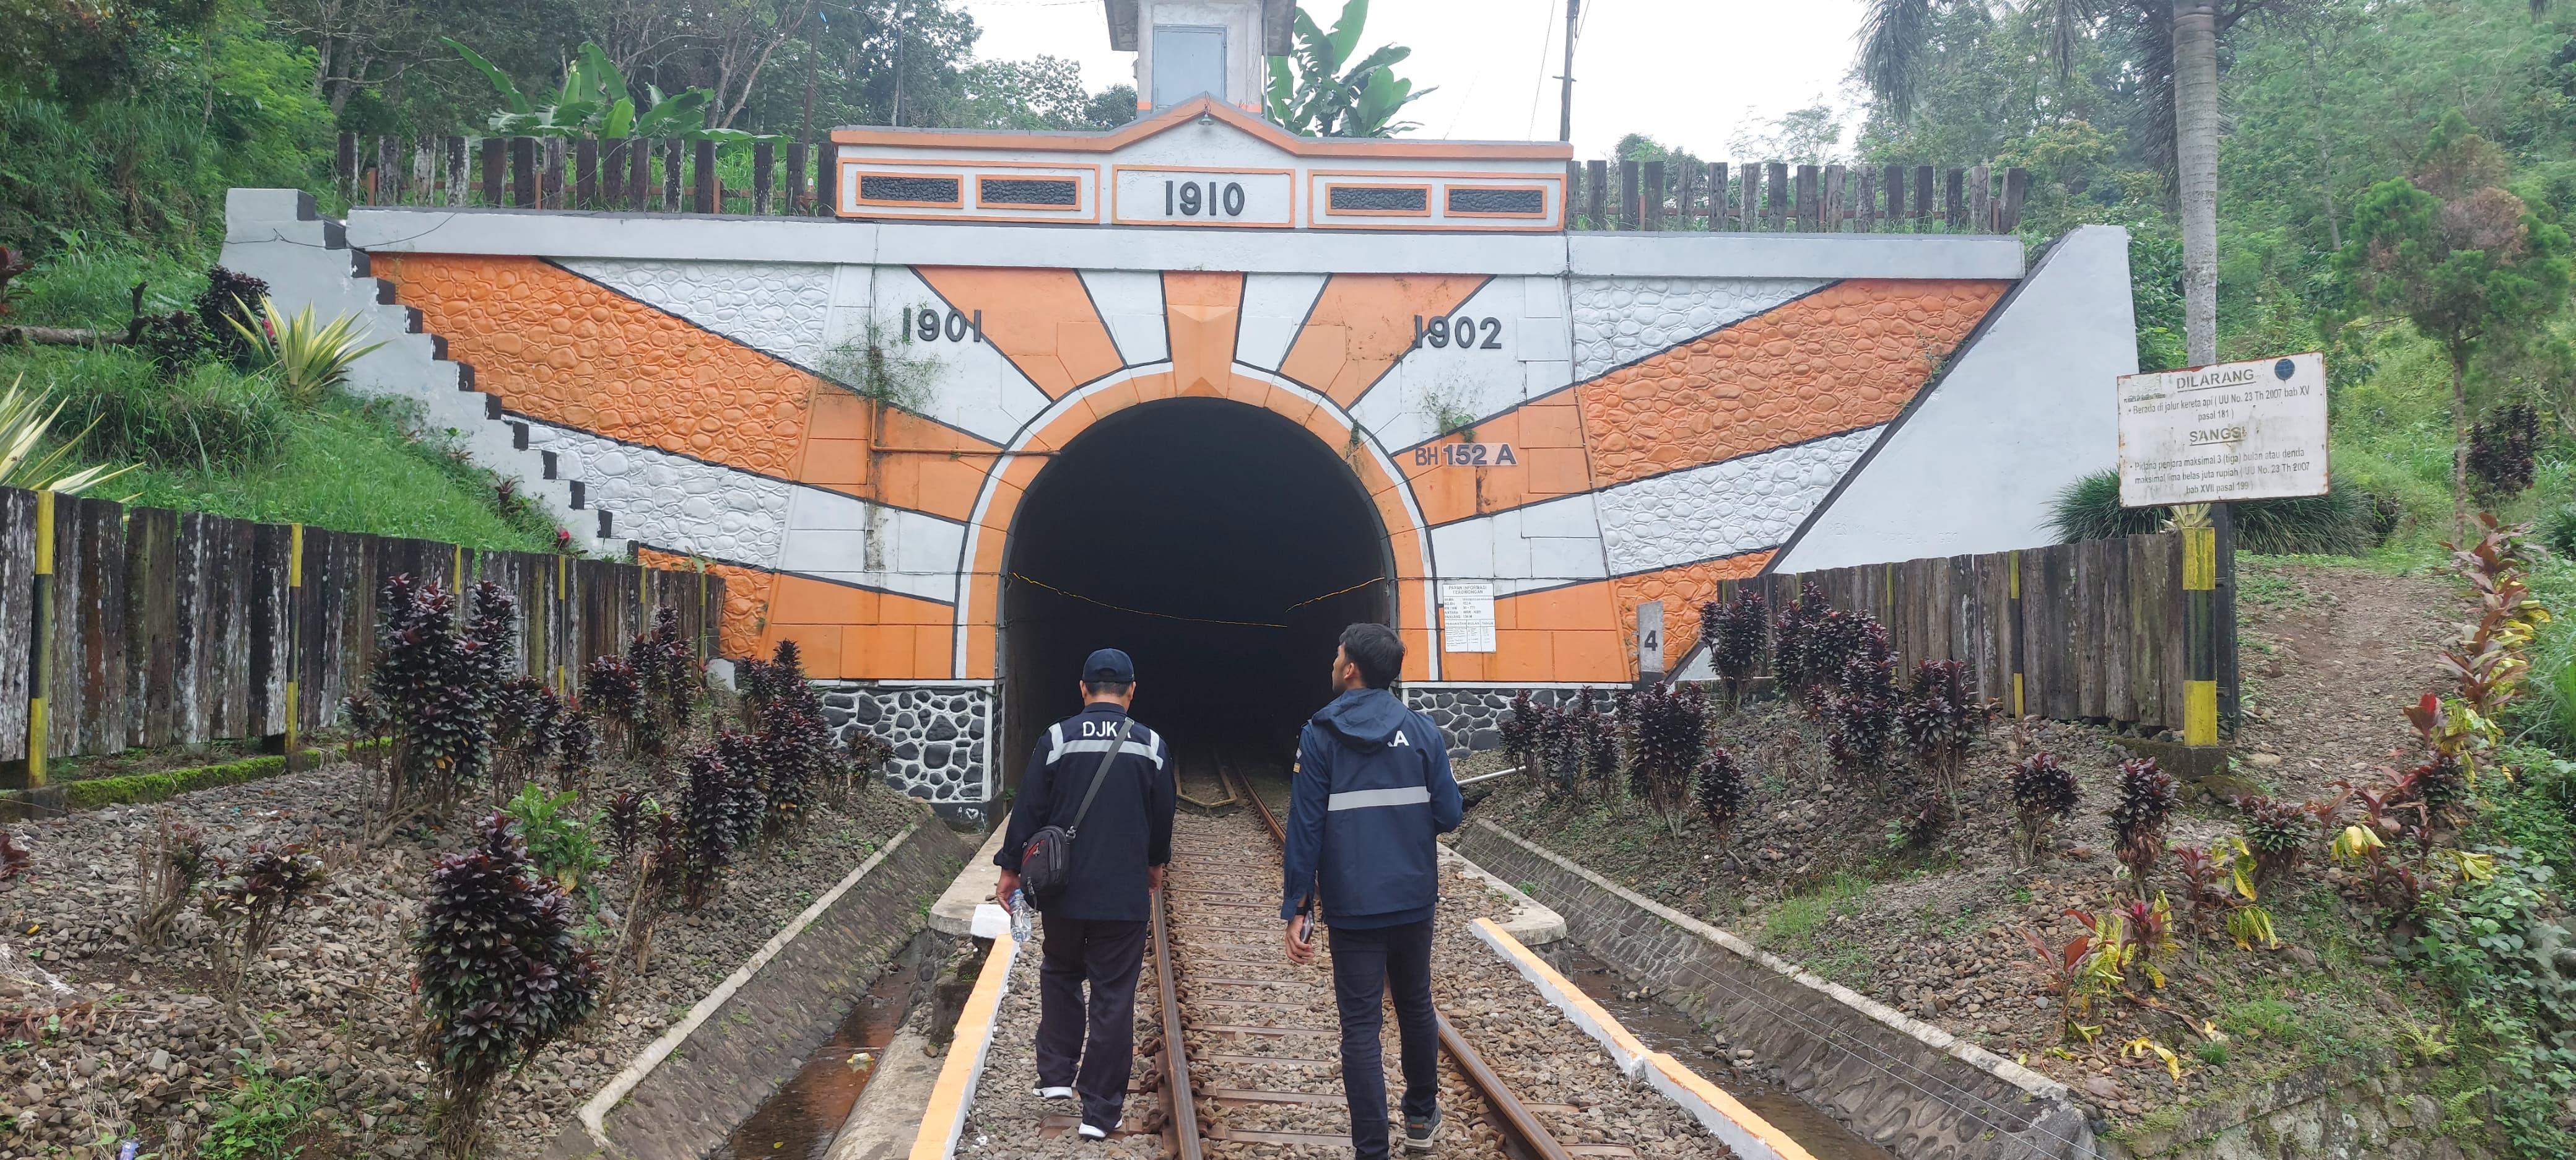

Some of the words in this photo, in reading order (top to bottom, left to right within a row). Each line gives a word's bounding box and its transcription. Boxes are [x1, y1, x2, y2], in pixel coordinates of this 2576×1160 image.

[1166, 180, 1245, 217] 1910
[902, 307, 982, 342] 1901
[1414, 315, 1502, 349] 1902
[2177, 368, 2254, 389] DILARANG
[2133, 404, 2156, 414] Berada
[2157, 403, 2164, 411] di
[2165, 401, 2180, 413] jalur
[2181, 399, 2201, 409] kereta
[2203, 398, 2213, 410] api
[2219, 395, 2229, 404] UU
[2231, 393, 2243, 403] No.
[2245, 392, 2253, 401] 23
[2255, 390, 2264, 400] Th
[2266, 388, 2282, 399] 2007
[2284, 386, 2298, 397] bab
[2300, 385, 2310, 396] XV
[2198, 411, 2216, 422] pasal
[2217, 409, 2229, 419] 181
[2190, 426, 2245, 442] SANGSI
[1415, 446, 1438, 466] BH
[1443, 444, 1487, 465] 152
[1495, 443, 1517, 464] A
[2135, 461, 2157, 471] Pidana
[2159, 459, 2182, 471] penjara
[2184, 455, 2216, 466] maksimal
[2217, 455, 2222, 464] 3
[2223, 452, 2241, 464] (tiga)
[2243, 451, 2263, 461] bulan
[2265, 450, 2280, 460] atau
[2282, 447, 2304, 458] denda
[2135, 473, 2166, 484] maksimal
[2167, 473, 2180, 481] lima
[2182, 471, 2200, 480] belas
[2201, 471, 2214, 481] juta
[2216, 468, 2239, 479] rupiah
[2258, 465, 2269, 474] No.
[2271, 464, 2280, 473] 23
[2282, 463, 2291, 473] Th
[2293, 461, 2310, 471] 2007
[2186, 484, 2199, 494] bab
[2201, 484, 2214, 493] XVII
[2216, 482, 2235, 494] pasal
[2237, 481, 2249, 491] 199
[1644, 630, 1658, 652] 4
[1082, 721, 1131, 739] DJK
